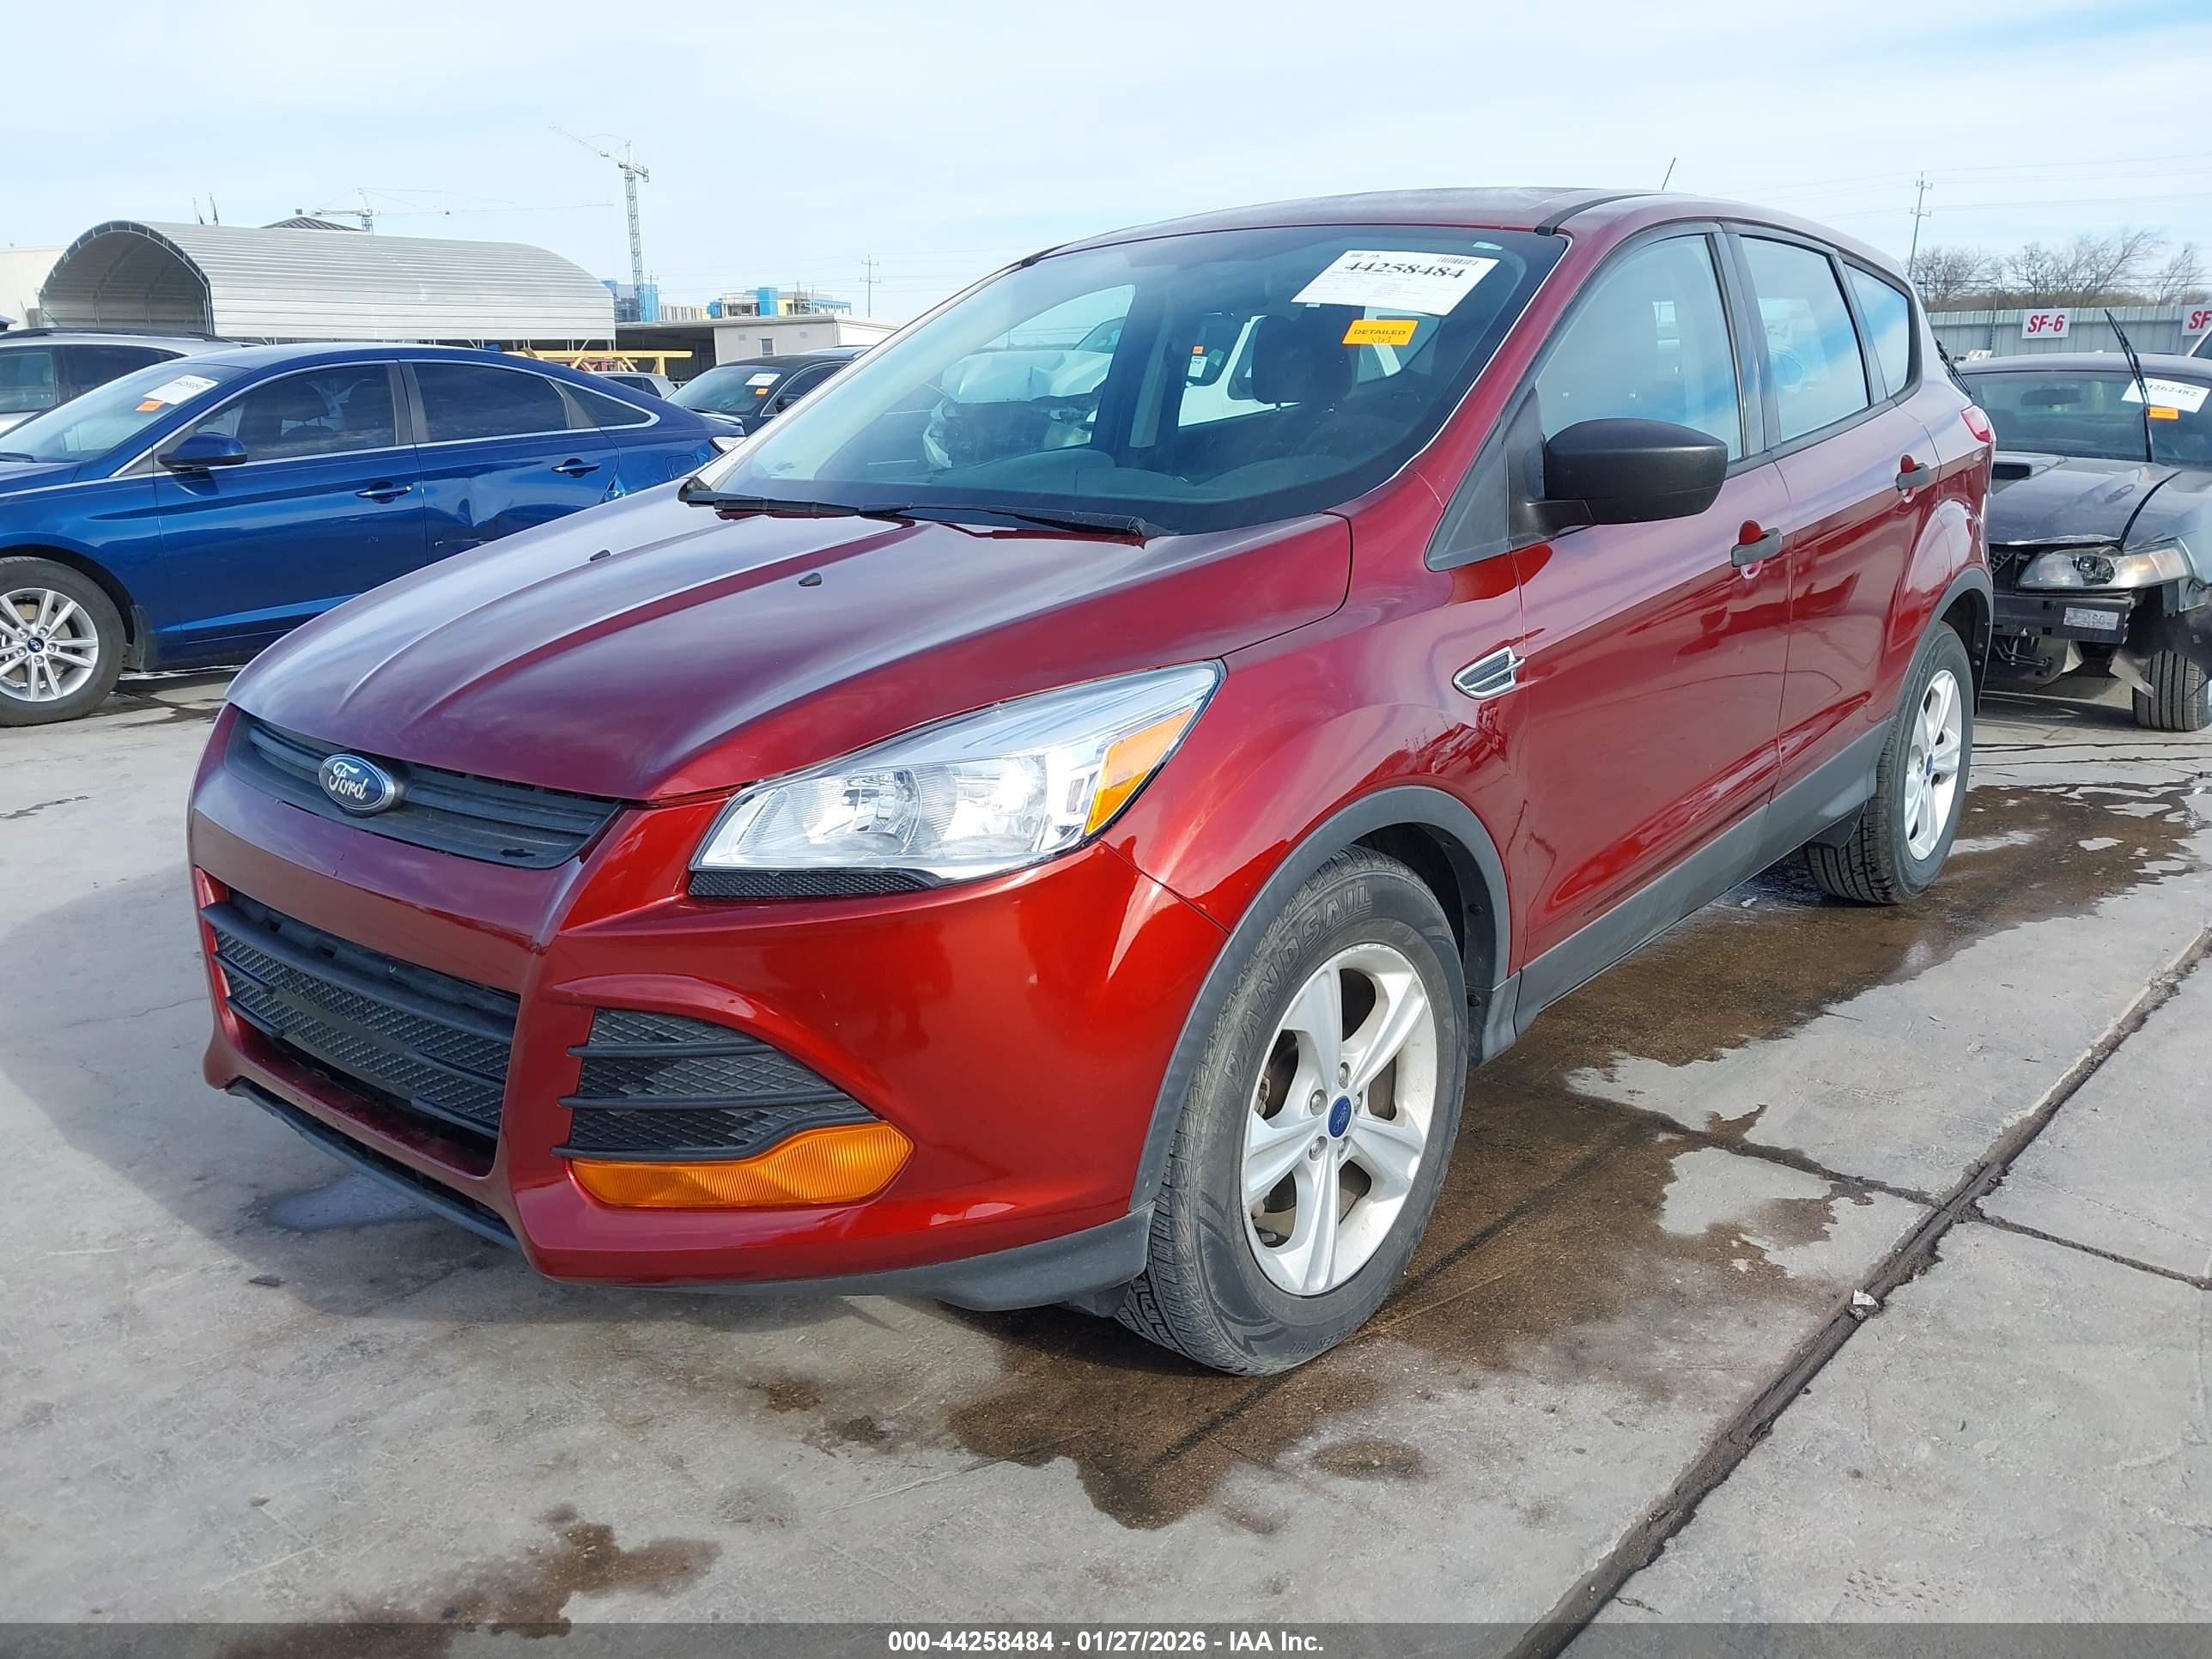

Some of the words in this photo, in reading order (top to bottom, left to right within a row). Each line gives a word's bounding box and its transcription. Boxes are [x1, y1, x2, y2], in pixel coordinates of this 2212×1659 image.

[1345, 261, 1466, 278] 44258484
[2027, 314, 2065, 332] SF-6
[328, 762, 368, 799] Ford
